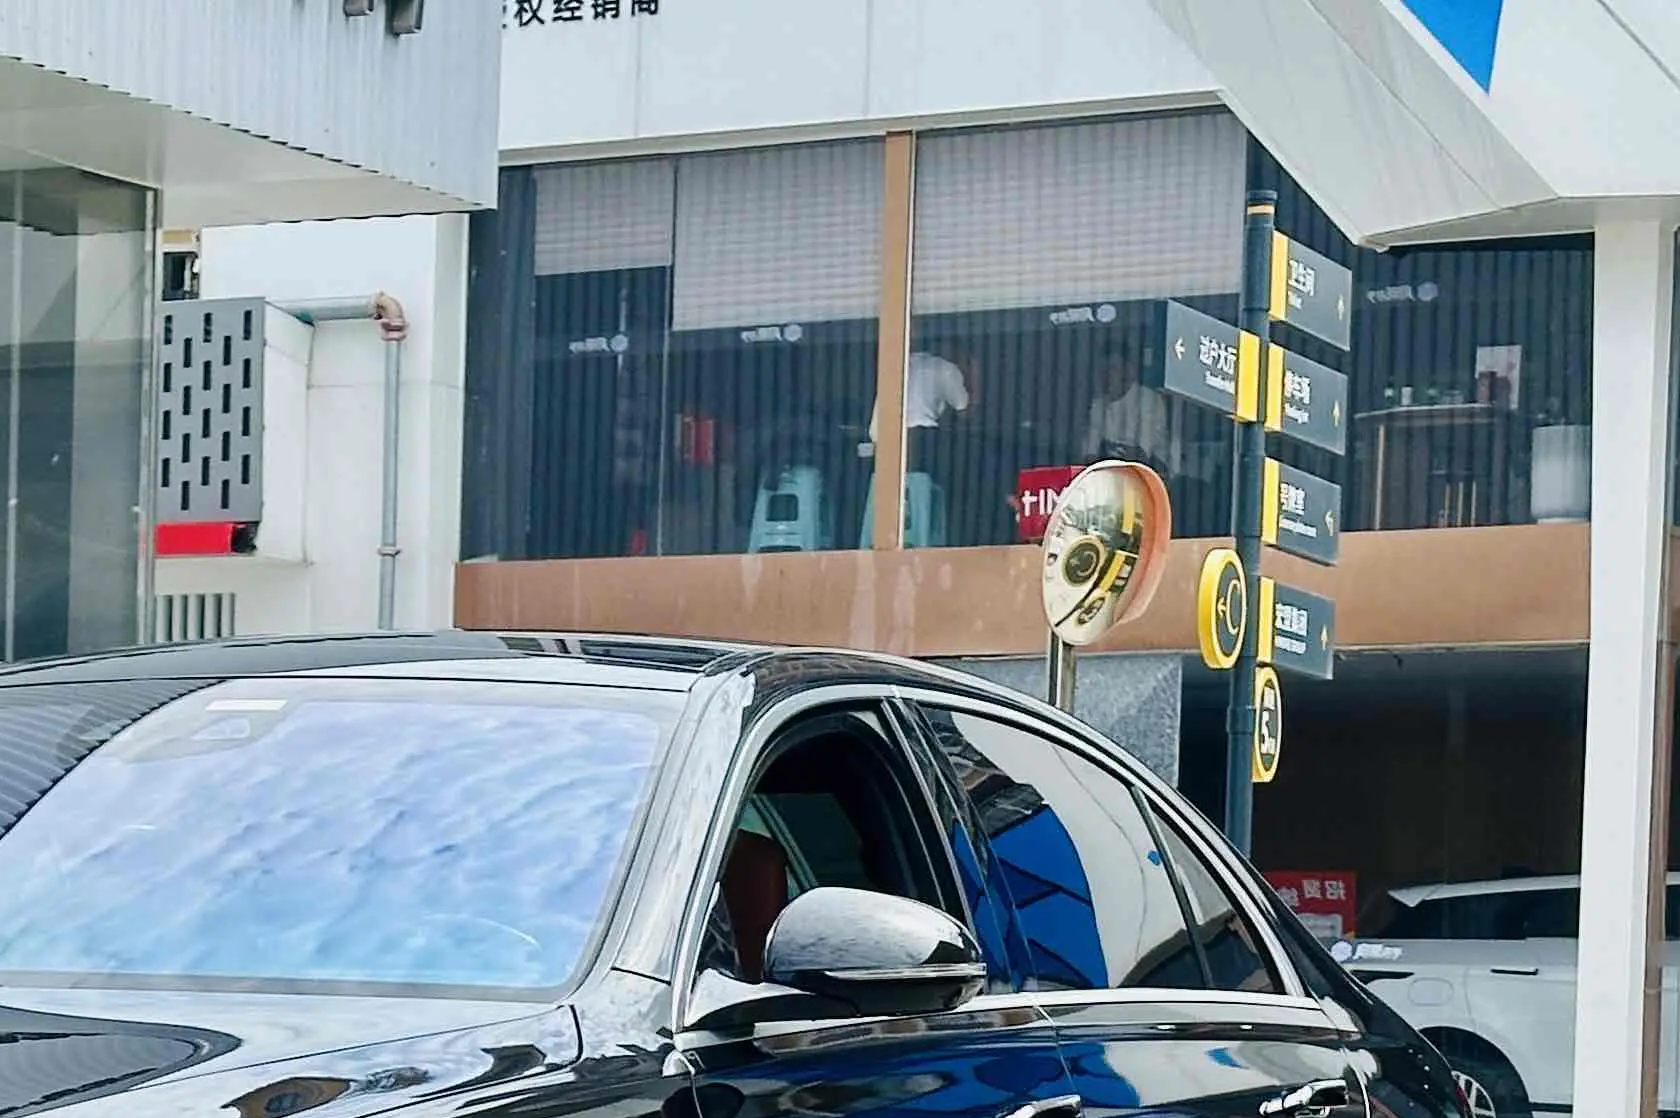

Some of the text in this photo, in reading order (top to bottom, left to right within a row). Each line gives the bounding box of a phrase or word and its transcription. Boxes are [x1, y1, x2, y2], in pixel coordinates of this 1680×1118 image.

[502, 0, 660, 27] 权经销商
[1284, 371, 1310, 404] 停车场
